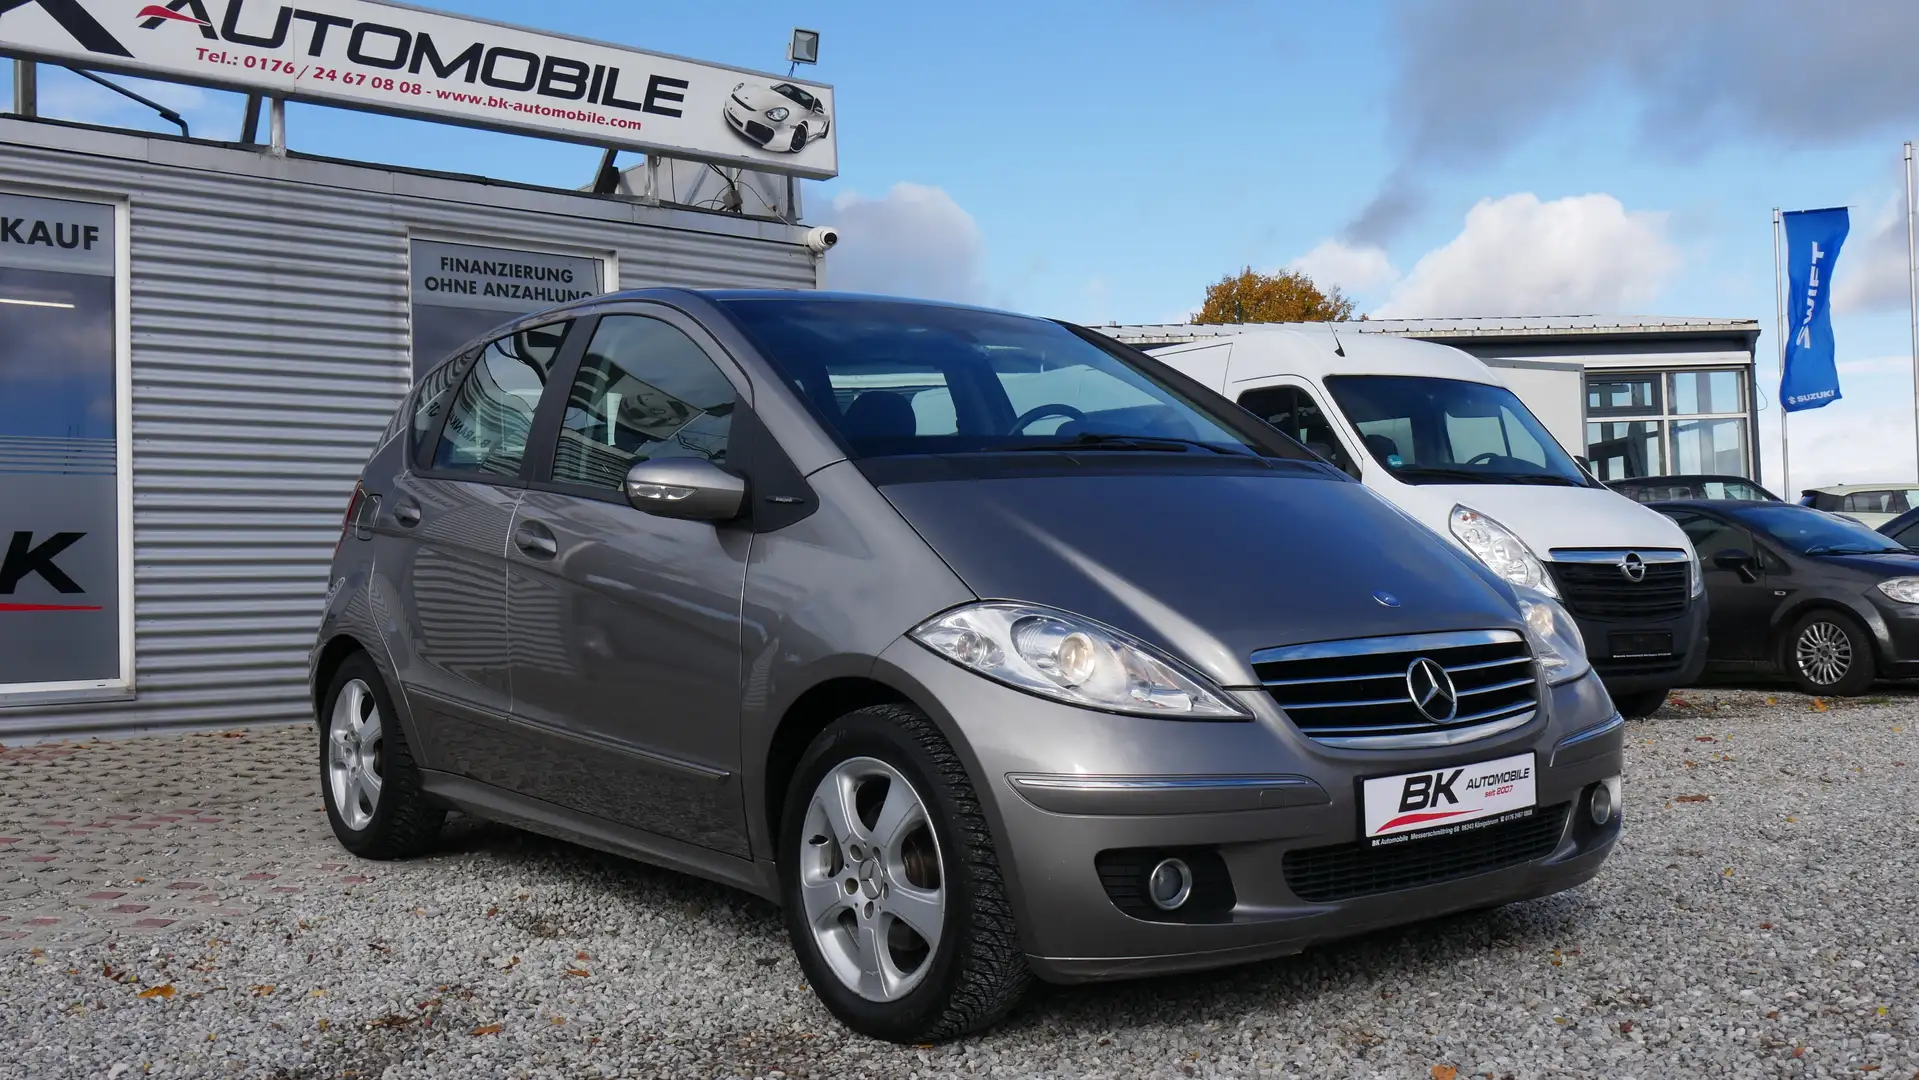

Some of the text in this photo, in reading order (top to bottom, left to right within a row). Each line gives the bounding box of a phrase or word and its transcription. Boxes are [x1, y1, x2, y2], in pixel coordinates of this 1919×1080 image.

[136, 0, 690, 118] AUTOMOBILE
[195, 47, 238, 66] Tel.:
[243, 55, 295, 74] 0176
[312, 66, 337, 82] 24
[342, 72, 367, 86] 67
[371, 76, 394, 91] 08
[399, 81, 422, 96] 08
[436, 88, 642, 131] www.bk-automobile.com
[0, 216, 99, 250] KAUF
[440, 256, 574, 284] FINANZIERUNG
[424, 276, 477, 295] OHNE
[1797, 389, 1835, 403] SUZUKI
[1398, 767, 1530, 813] BK AUTOMOBILE
[1484, 784, 1514, 797] seit 2007
[1380, 834, 1409, 845] Automobile
